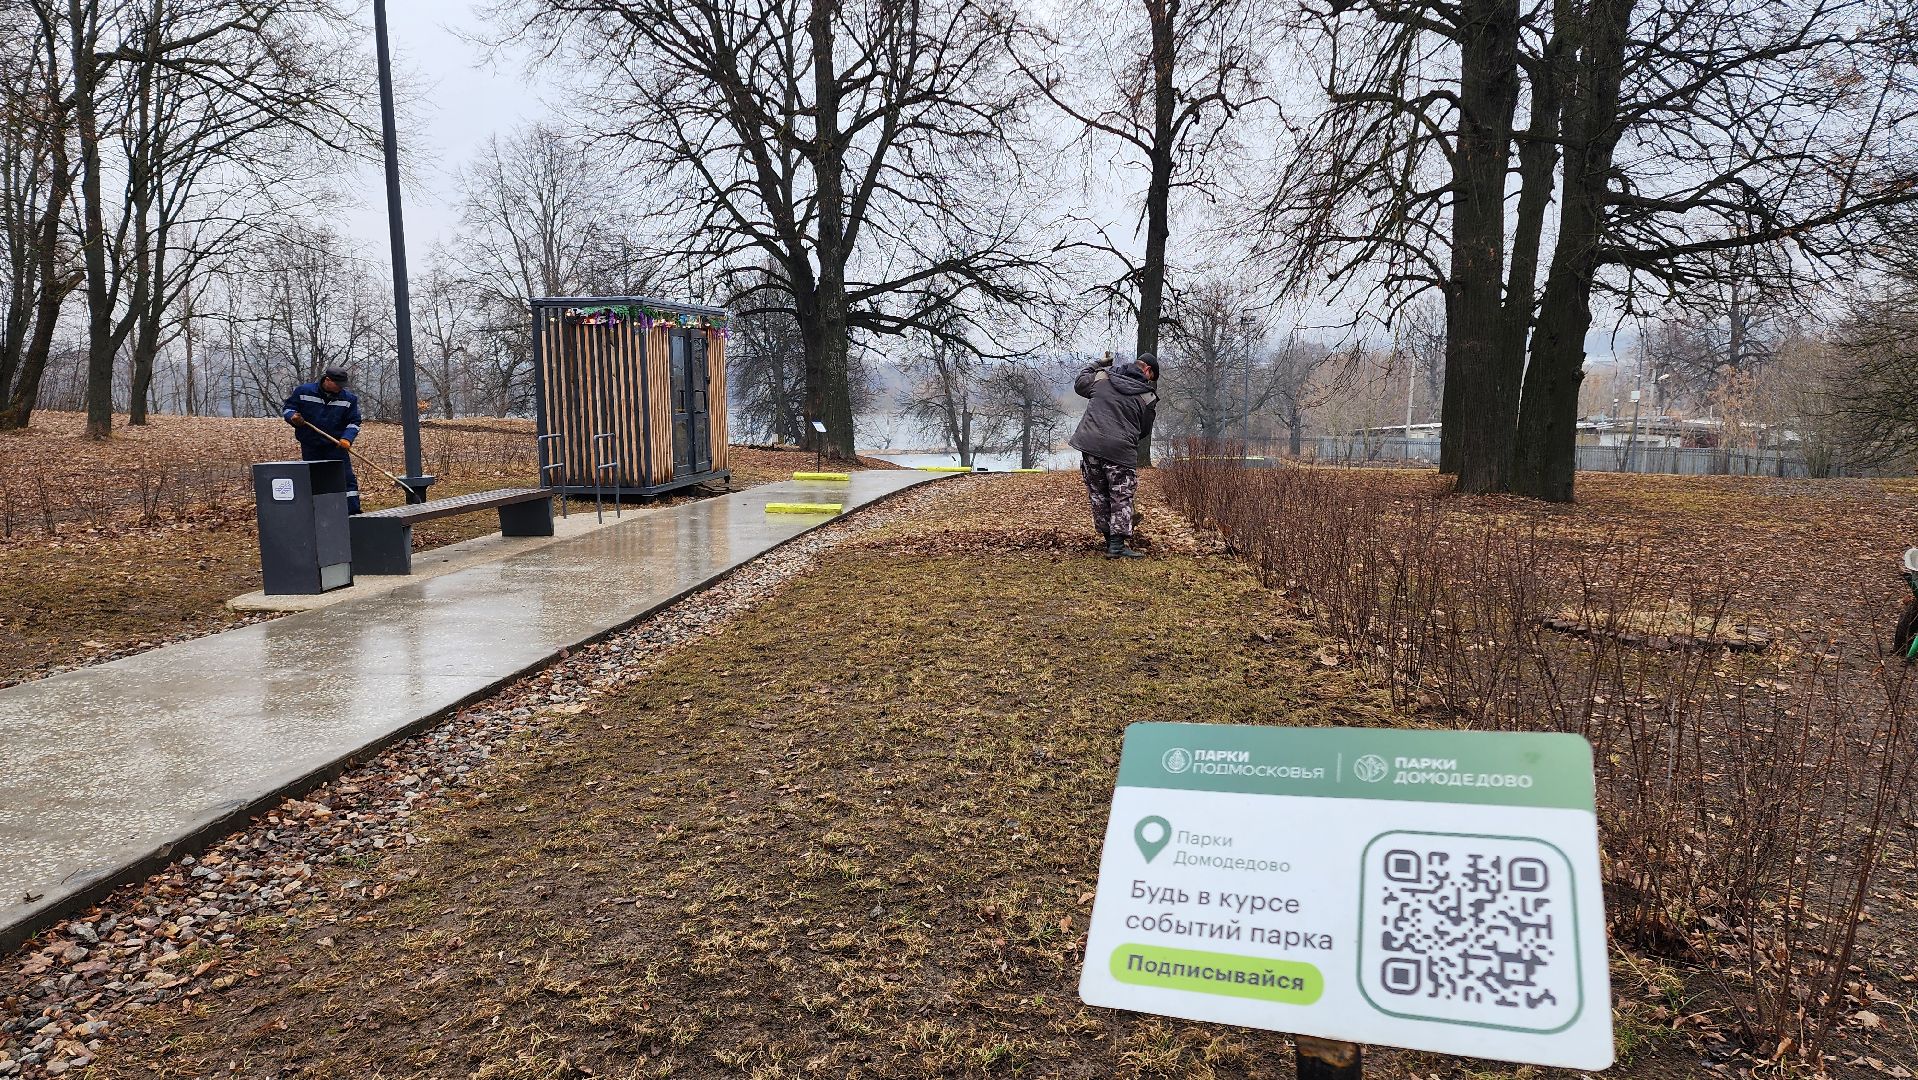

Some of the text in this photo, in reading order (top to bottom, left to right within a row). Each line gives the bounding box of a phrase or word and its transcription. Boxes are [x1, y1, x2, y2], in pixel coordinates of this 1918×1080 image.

[1194, 749, 1250, 763] ПАРКИ
[1394, 756, 1457, 771] ПАРКИ
[1192, 762, 1325, 780] ПОДМОСКОВЬЯ
[1392, 770, 1534, 788] ДОМОДЕДОВО
[1176, 830, 1233, 849] Парки
[1173, 850, 1291, 873] Домодедово
[1131, 879, 1300, 915] Будь в курсе
[1125, 912, 1334, 951] событий парка
[1127, 953, 1305, 992] Подписывайся
